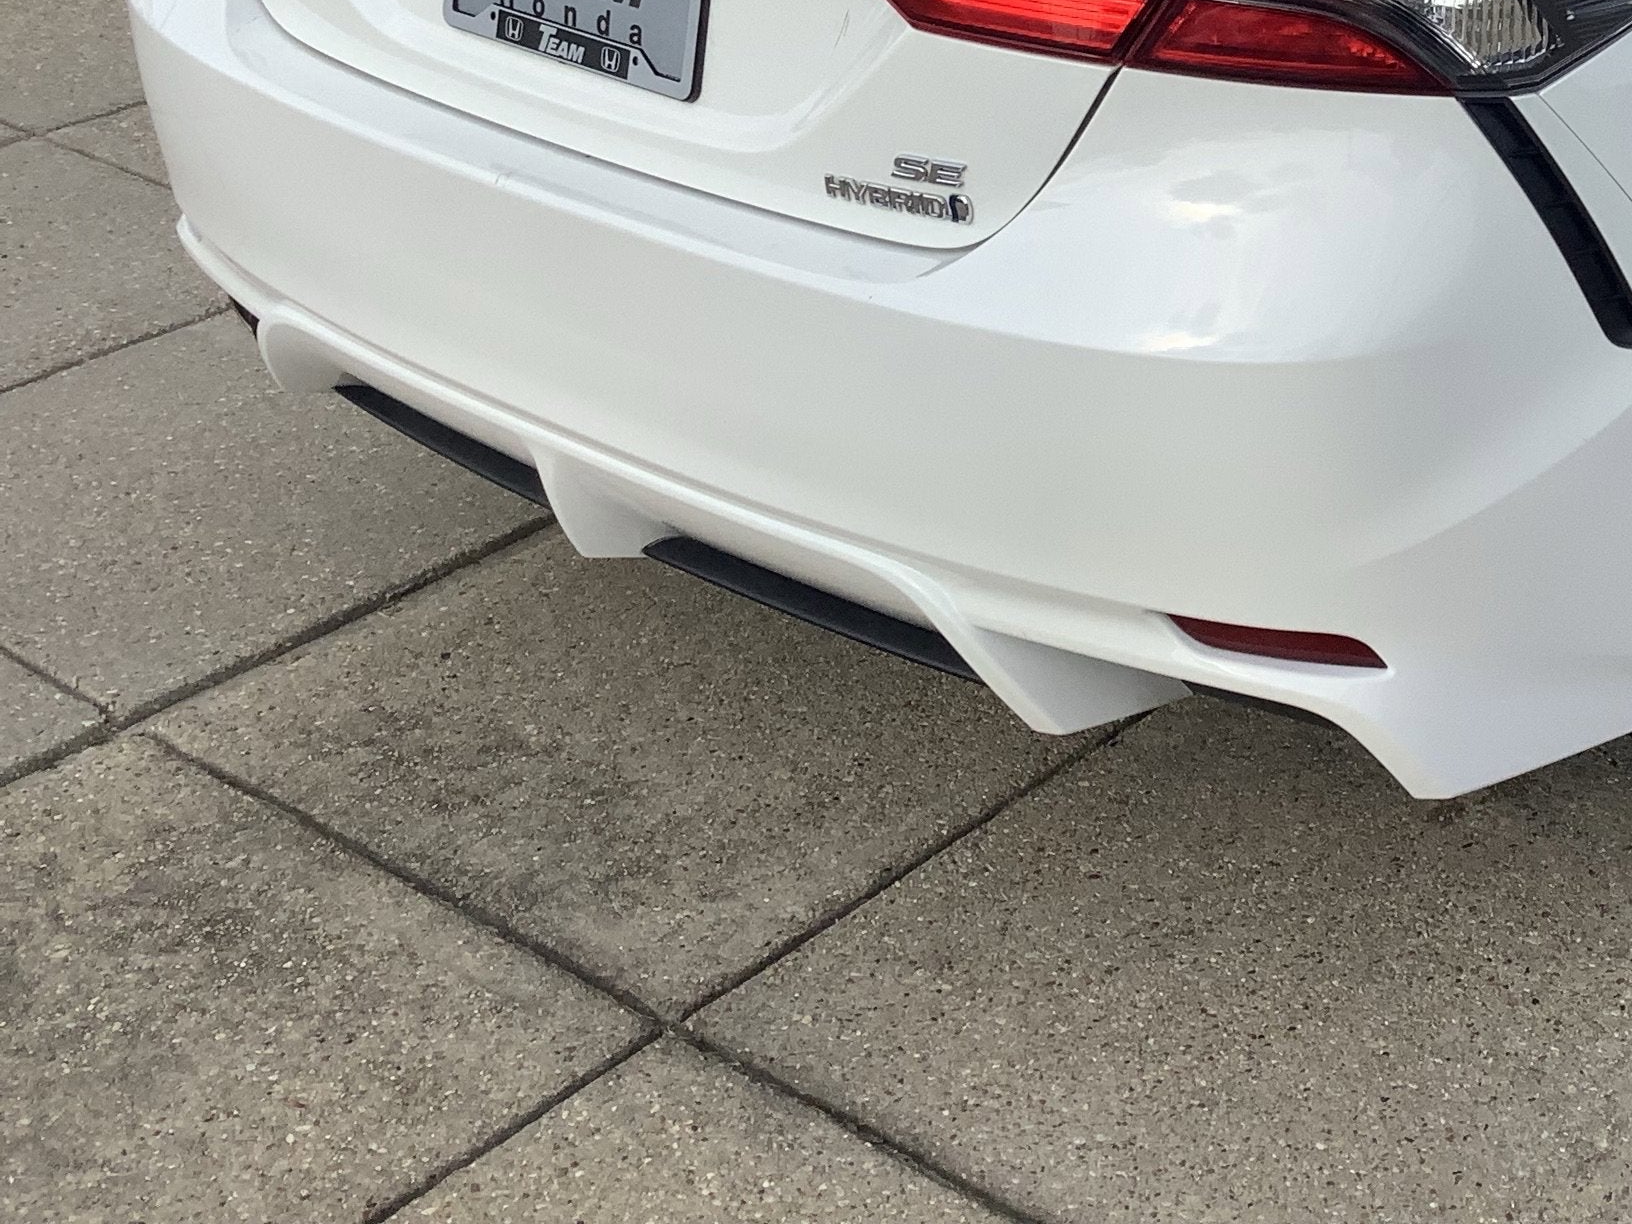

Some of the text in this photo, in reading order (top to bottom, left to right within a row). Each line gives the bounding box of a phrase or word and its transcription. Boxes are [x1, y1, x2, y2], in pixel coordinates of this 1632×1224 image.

[538, 24, 586, 64] TEAM
[891, 152, 968, 189] SE
[824, 172, 949, 220] HYBRID
